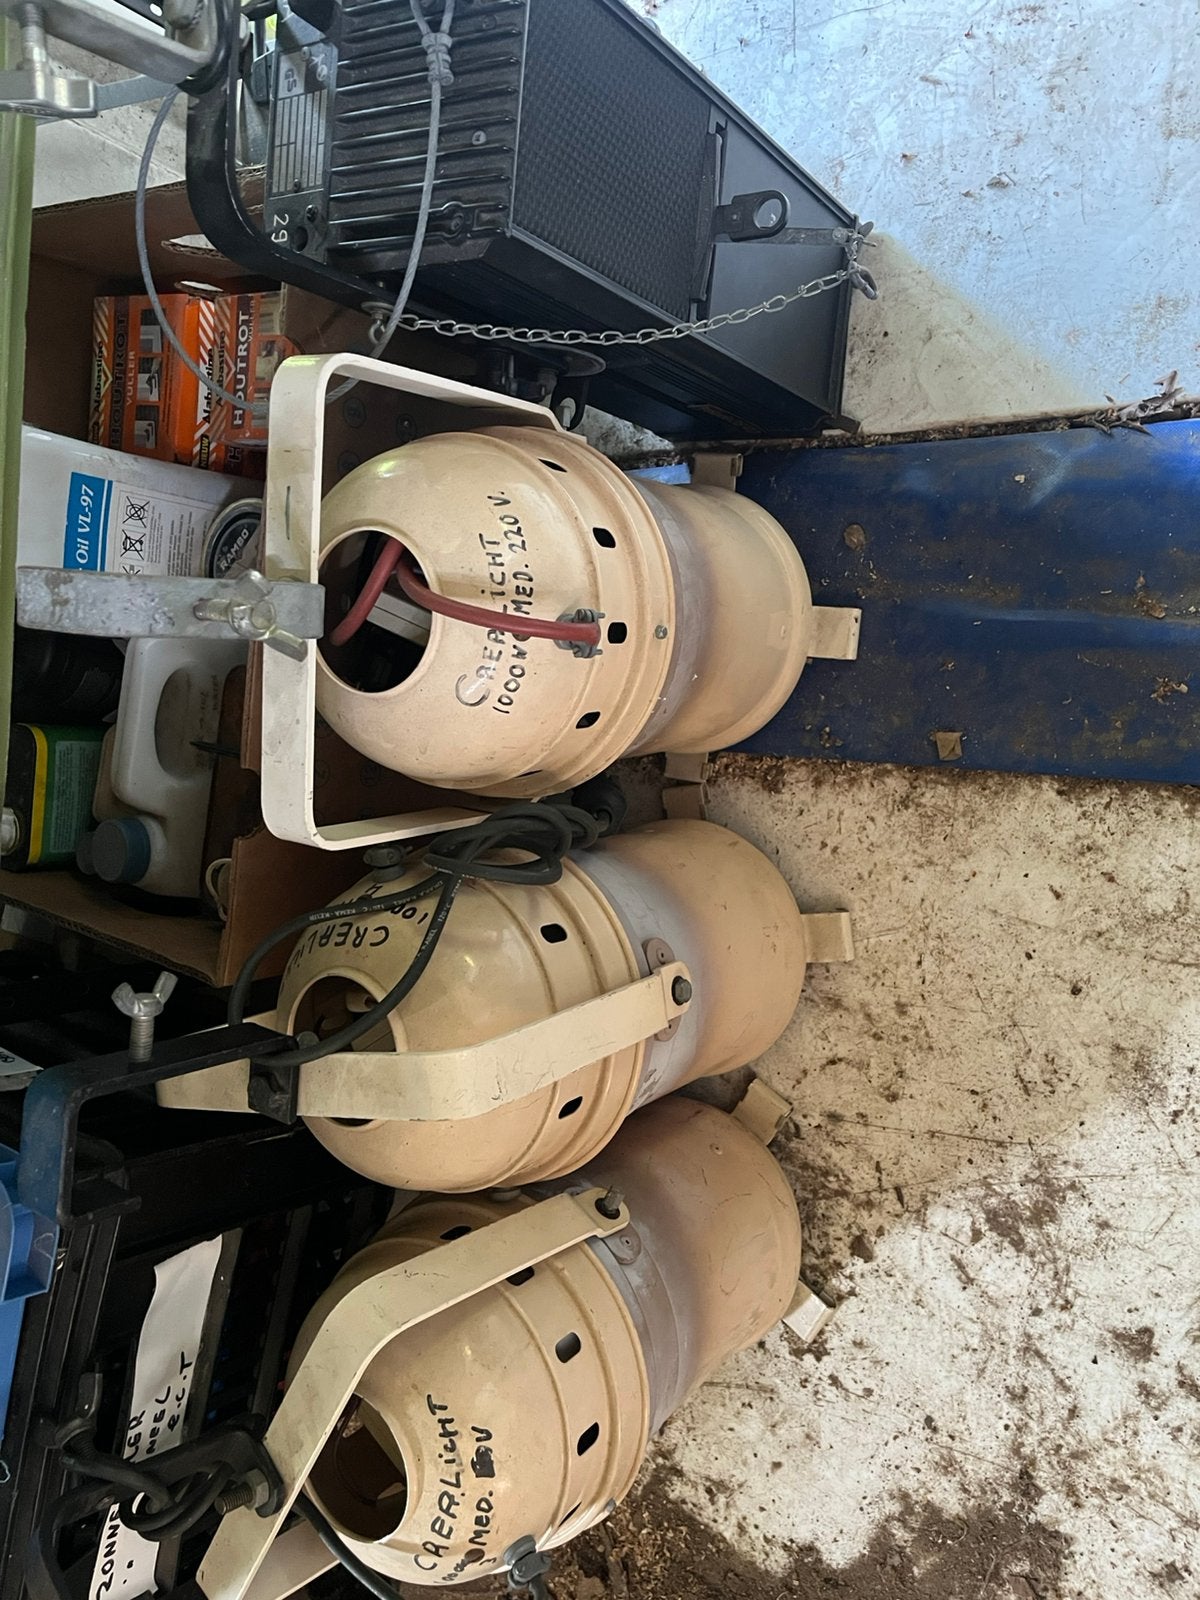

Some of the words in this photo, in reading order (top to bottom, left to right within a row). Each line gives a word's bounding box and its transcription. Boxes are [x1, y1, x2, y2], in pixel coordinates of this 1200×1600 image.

[271, 213, 289, 243] 29
[126, 350, 136, 406] VULLER
[201, 437, 210, 467] NIEUW
[78, 484, 95, 533] VL-97
[76, 540, 89, 565] Oil
[219, 528, 249, 571] RAMBO
[499, 514, 527, 554] 220
